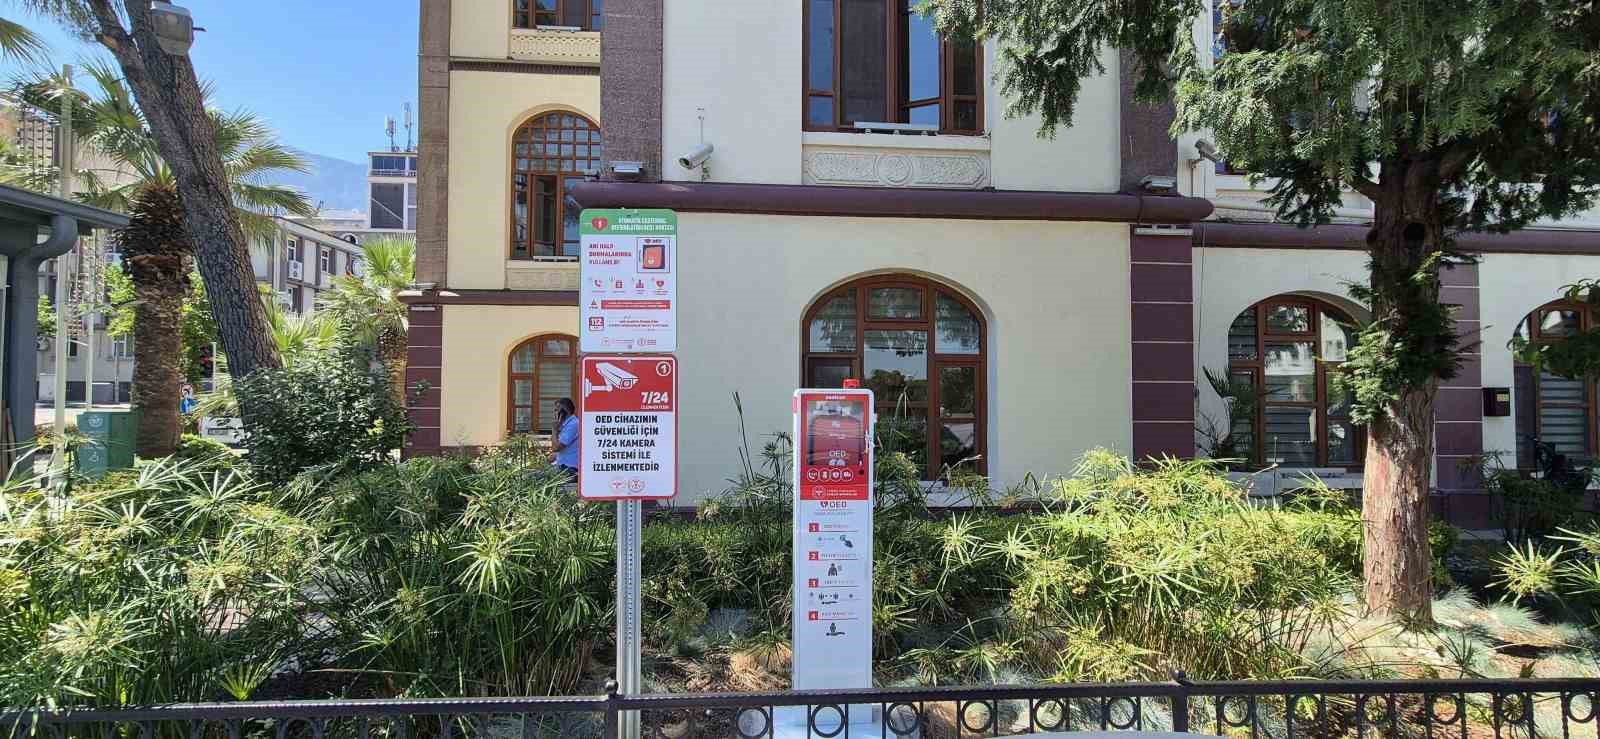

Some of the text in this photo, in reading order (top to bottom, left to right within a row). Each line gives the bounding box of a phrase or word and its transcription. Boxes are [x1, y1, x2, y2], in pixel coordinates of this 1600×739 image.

[640, 391, 668, 404] 7/24
[595, 413, 658, 424] OED CİHAZININ
[594, 425, 659, 437] GÜVENLİĞİ İÇİN
[597, 439, 656, 448] 7/24 KAMERA
[602, 449, 651, 459] SİSTEMİ İLE
[593, 461, 659, 472] İZLENMEKTEDİR
